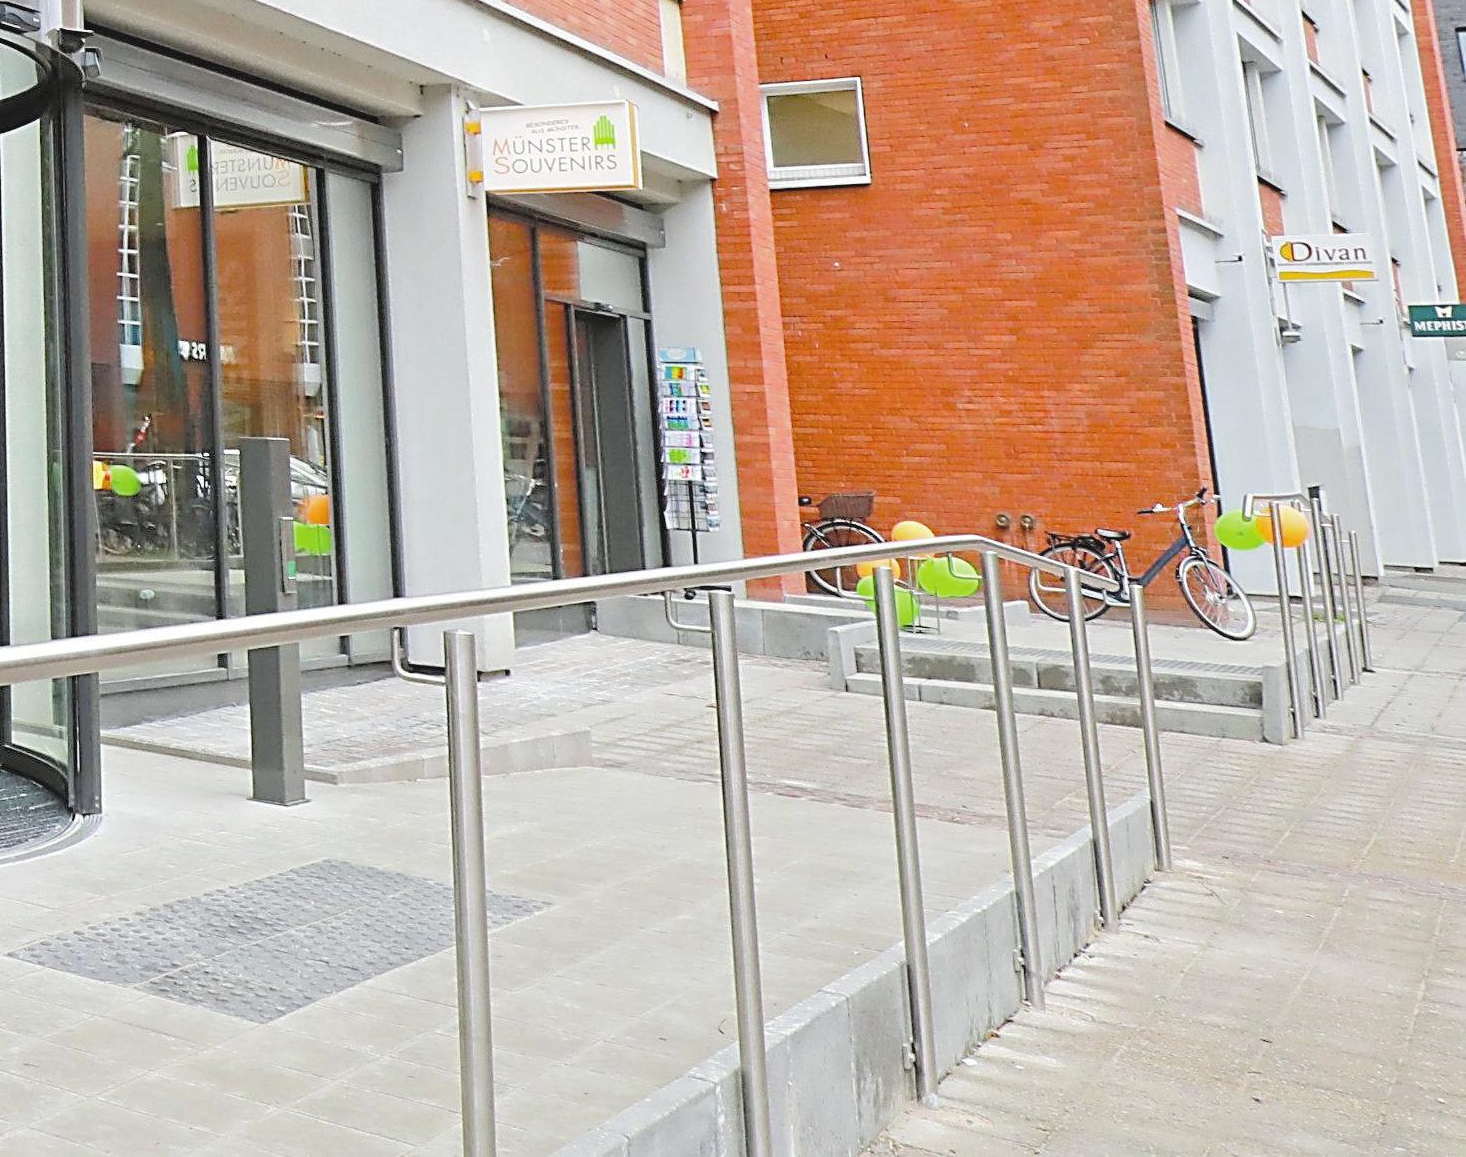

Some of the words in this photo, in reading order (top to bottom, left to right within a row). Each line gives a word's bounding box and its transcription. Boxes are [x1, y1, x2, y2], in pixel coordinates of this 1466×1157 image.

[493, 135, 590, 156] MÜNSTER
[494, 154, 618, 175] SOUVENIRS
[1280, 241, 1367, 262] Divan
[1414, 320, 1466, 331] MEPHIS
